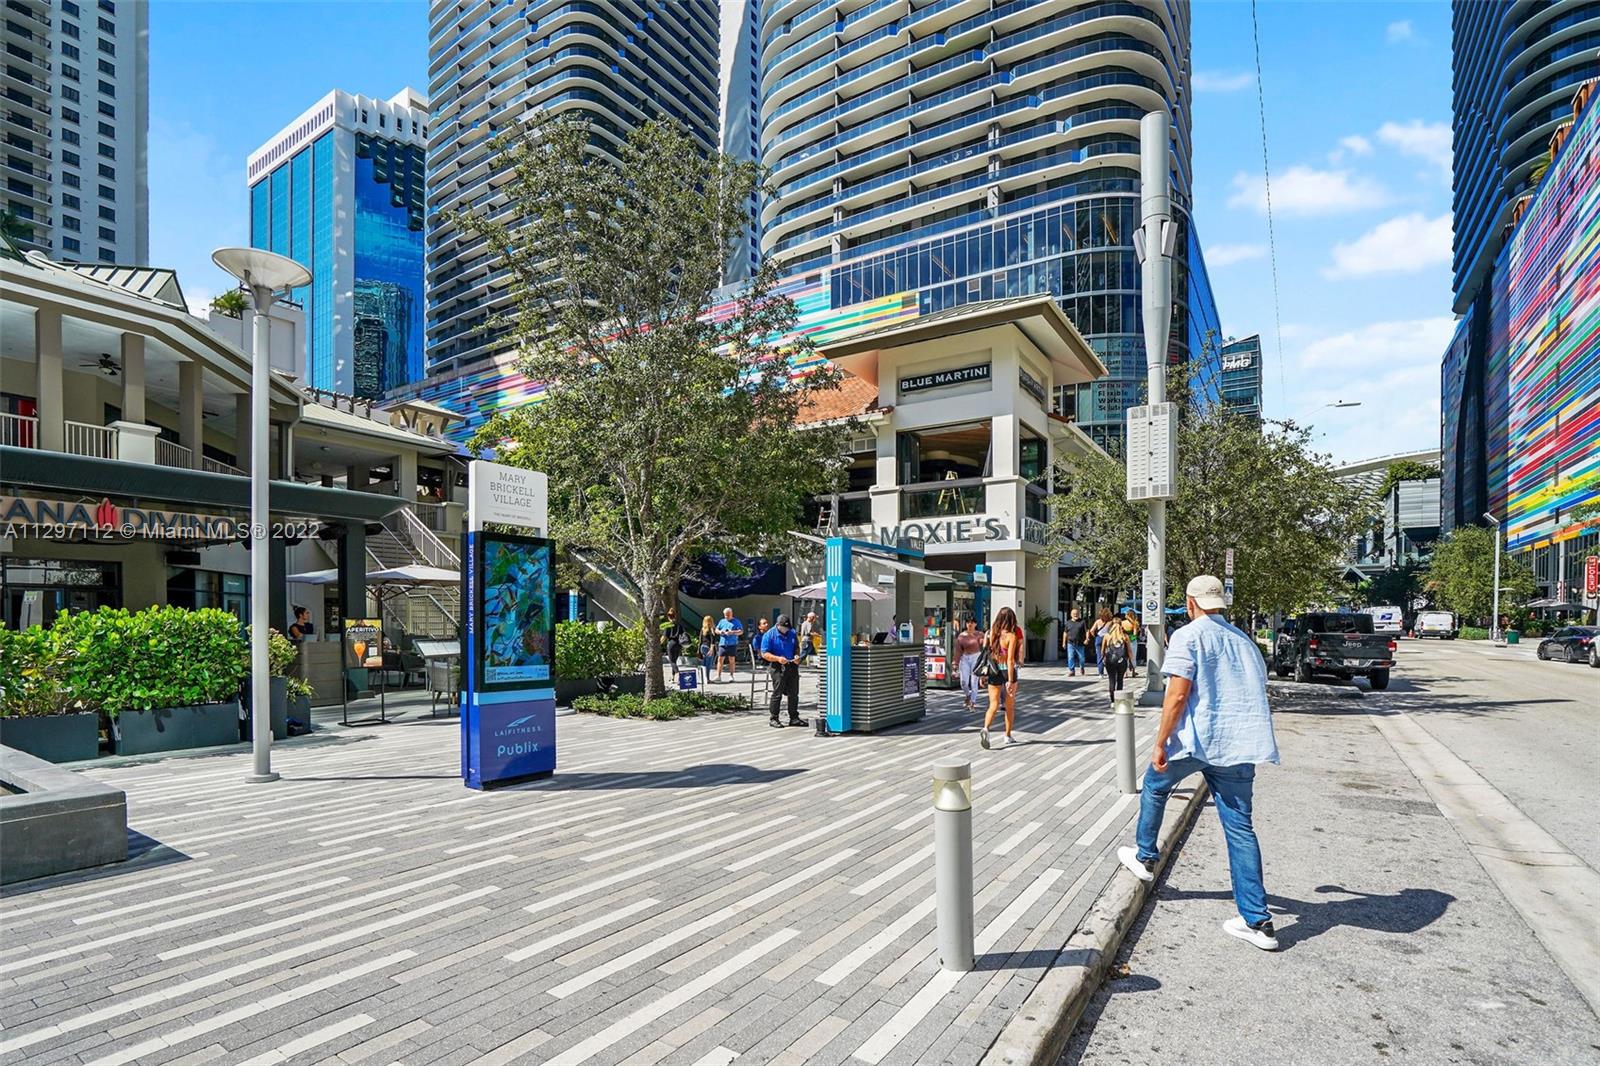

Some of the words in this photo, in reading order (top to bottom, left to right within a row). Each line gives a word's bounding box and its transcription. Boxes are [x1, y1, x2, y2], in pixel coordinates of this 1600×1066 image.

[901, 376, 933, 389] BLUE
[936, 367, 987, 384] MARTINI
[499, 471, 526, 484] MARY
[490, 482, 535, 497] BRICKELL
[493, 494, 532, 507] VILLAGE
[0, 498, 95, 527] ANA
[122, 508, 235, 540] DIVINO
[880, 517, 1000, 546] MOXIE'S
[1588, 558, 1596, 590] CHIPOTLE
[830, 581, 839, 649] VALET
[1342, 640, 1362, 649] Jeep
[497, 741, 538, 757] Publix
